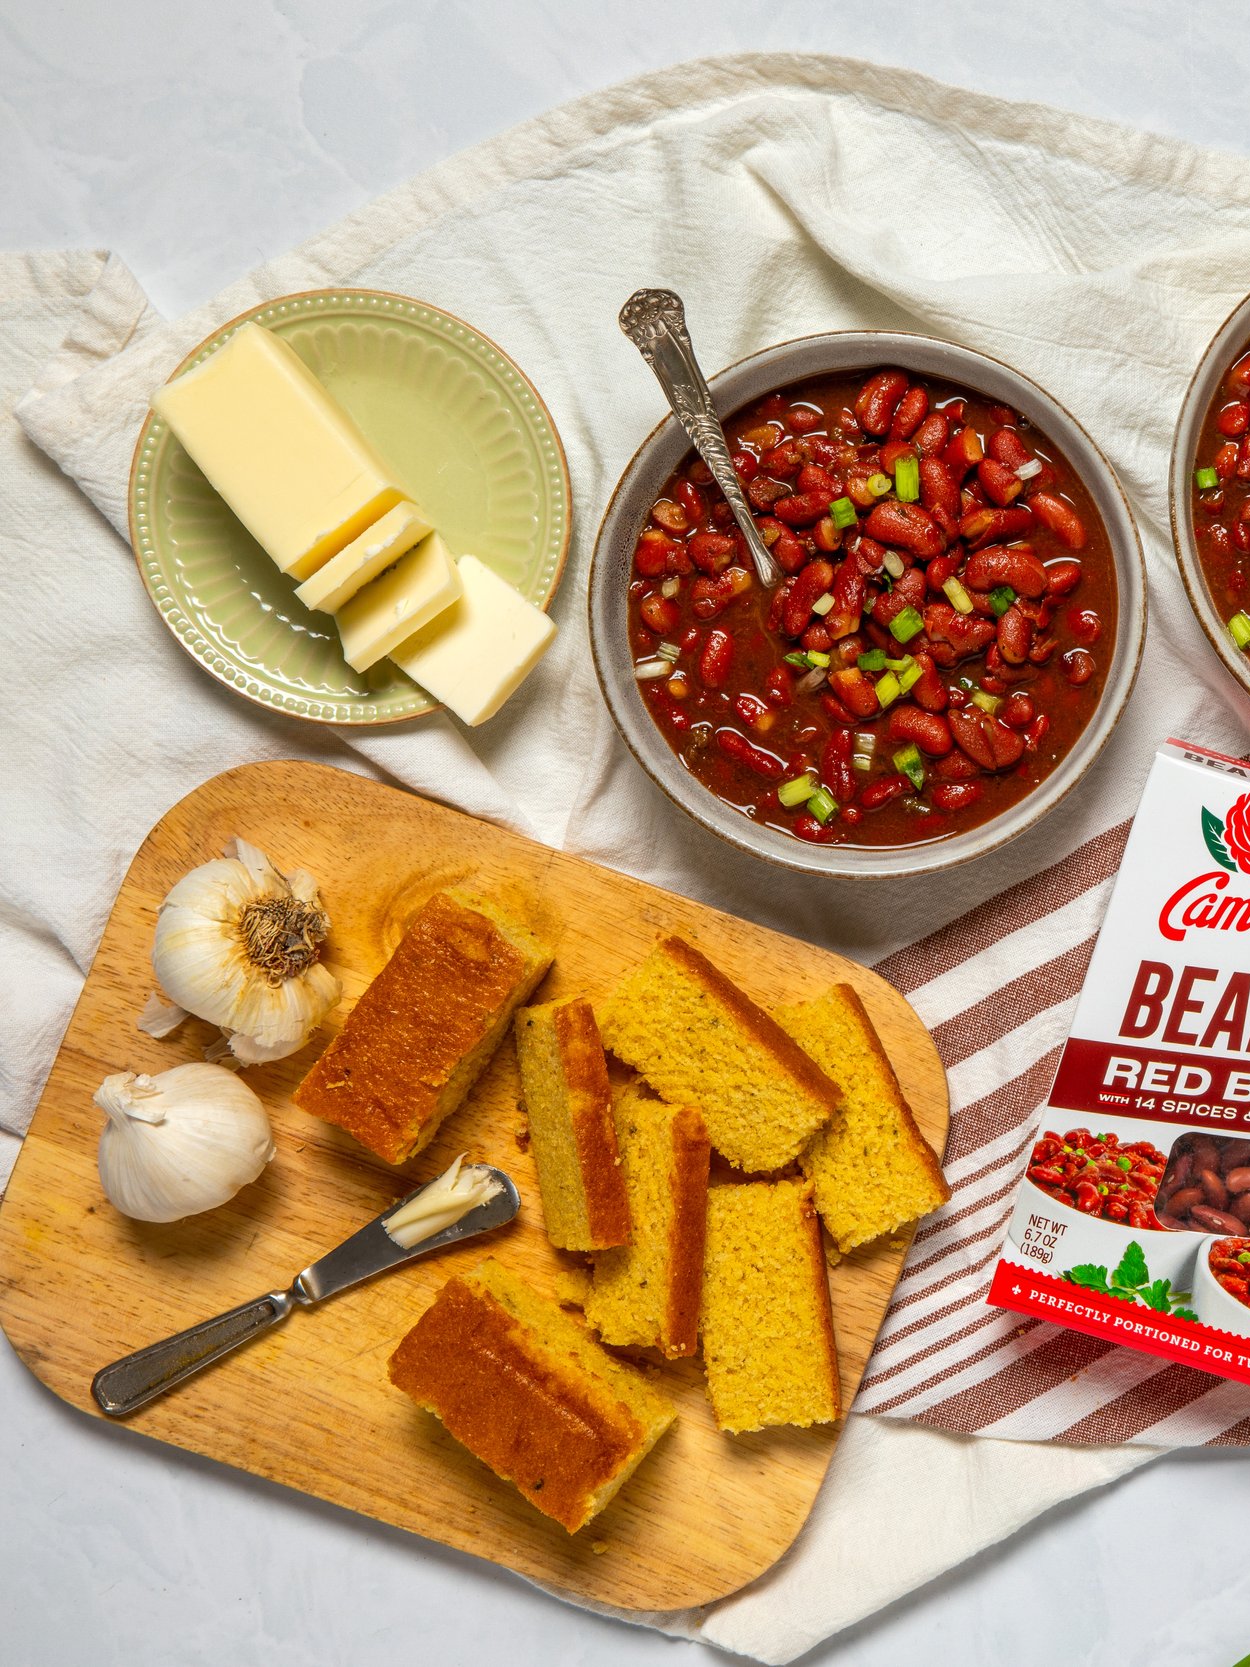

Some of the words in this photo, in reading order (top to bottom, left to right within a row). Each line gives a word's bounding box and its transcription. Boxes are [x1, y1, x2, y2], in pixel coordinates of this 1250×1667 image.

[1102, 1056, 1211, 1096] RED
[1099, 1092, 1130, 1106] WITH
[1134, 1096, 1156, 1111] 14
[1162, 1100, 1238, 1122] SPICES
[1028, 1214, 1051, 1230] NET
[1051, 1221, 1068, 1236] WT
[1024, 1228, 1042, 1243] 6.7
[1042, 1234, 1058, 1249] OZ
[1020, 1242, 1053, 1264] (189g)
[1029, 1290, 1111, 1324] PERFECTLY
[1113, 1317, 1201, 1351] PORTIONED
[1204, 1345, 1233, 1362] FOR
